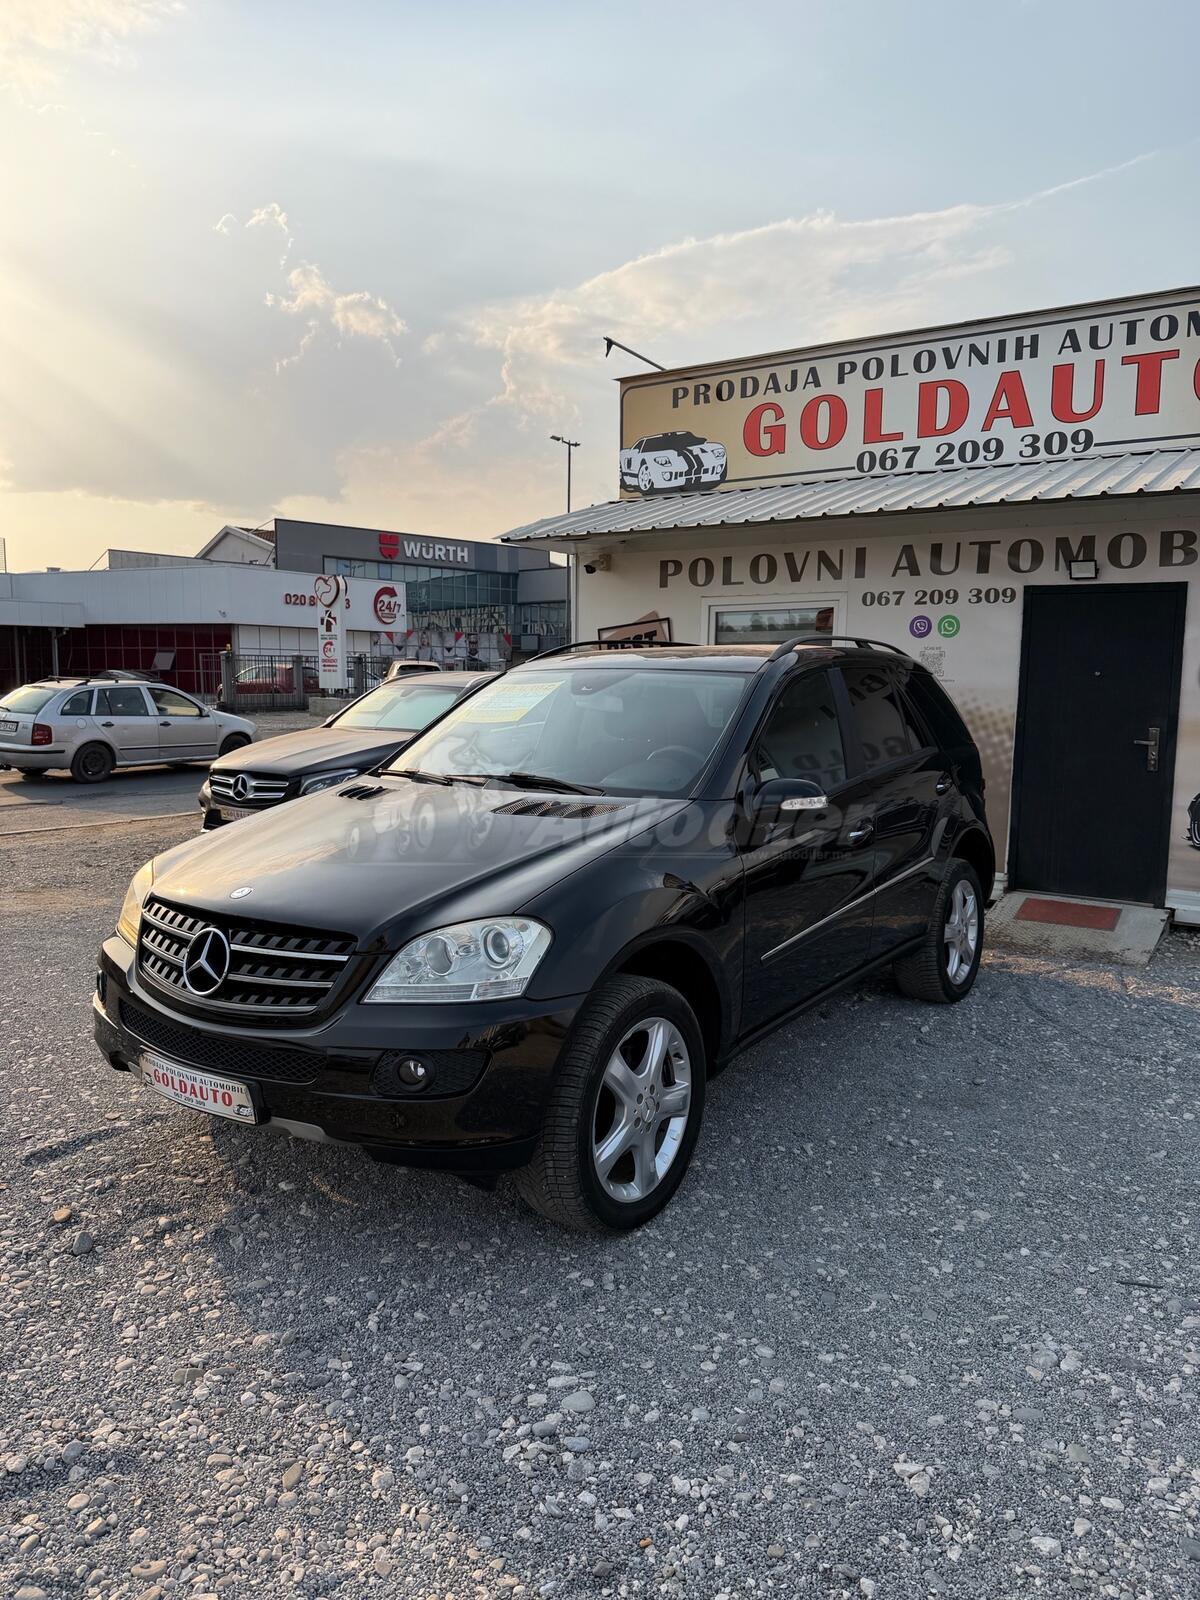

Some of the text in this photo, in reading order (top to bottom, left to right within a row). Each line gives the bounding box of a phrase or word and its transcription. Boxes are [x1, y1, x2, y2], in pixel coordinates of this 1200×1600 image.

[672, 367, 822, 409] PRODAJA
[837, 333, 1040, 385] POLOVNIH
[743, 349, 1200, 457] GOLDAUT
[856, 428, 1094, 473] 067 209 309
[403, 540, 469, 563] WÜRTH
[659, 530, 1199, 588] POLOVNI AUTOMOB
[285, 593, 307, 606] 020
[379, 599, 402, 613] 24/7
[861, 587, 1017, 607] 067 209 309
[153, 1069, 233, 1107] GOLDAUTO
[166, 1066, 198, 1083] POLOVNIH
